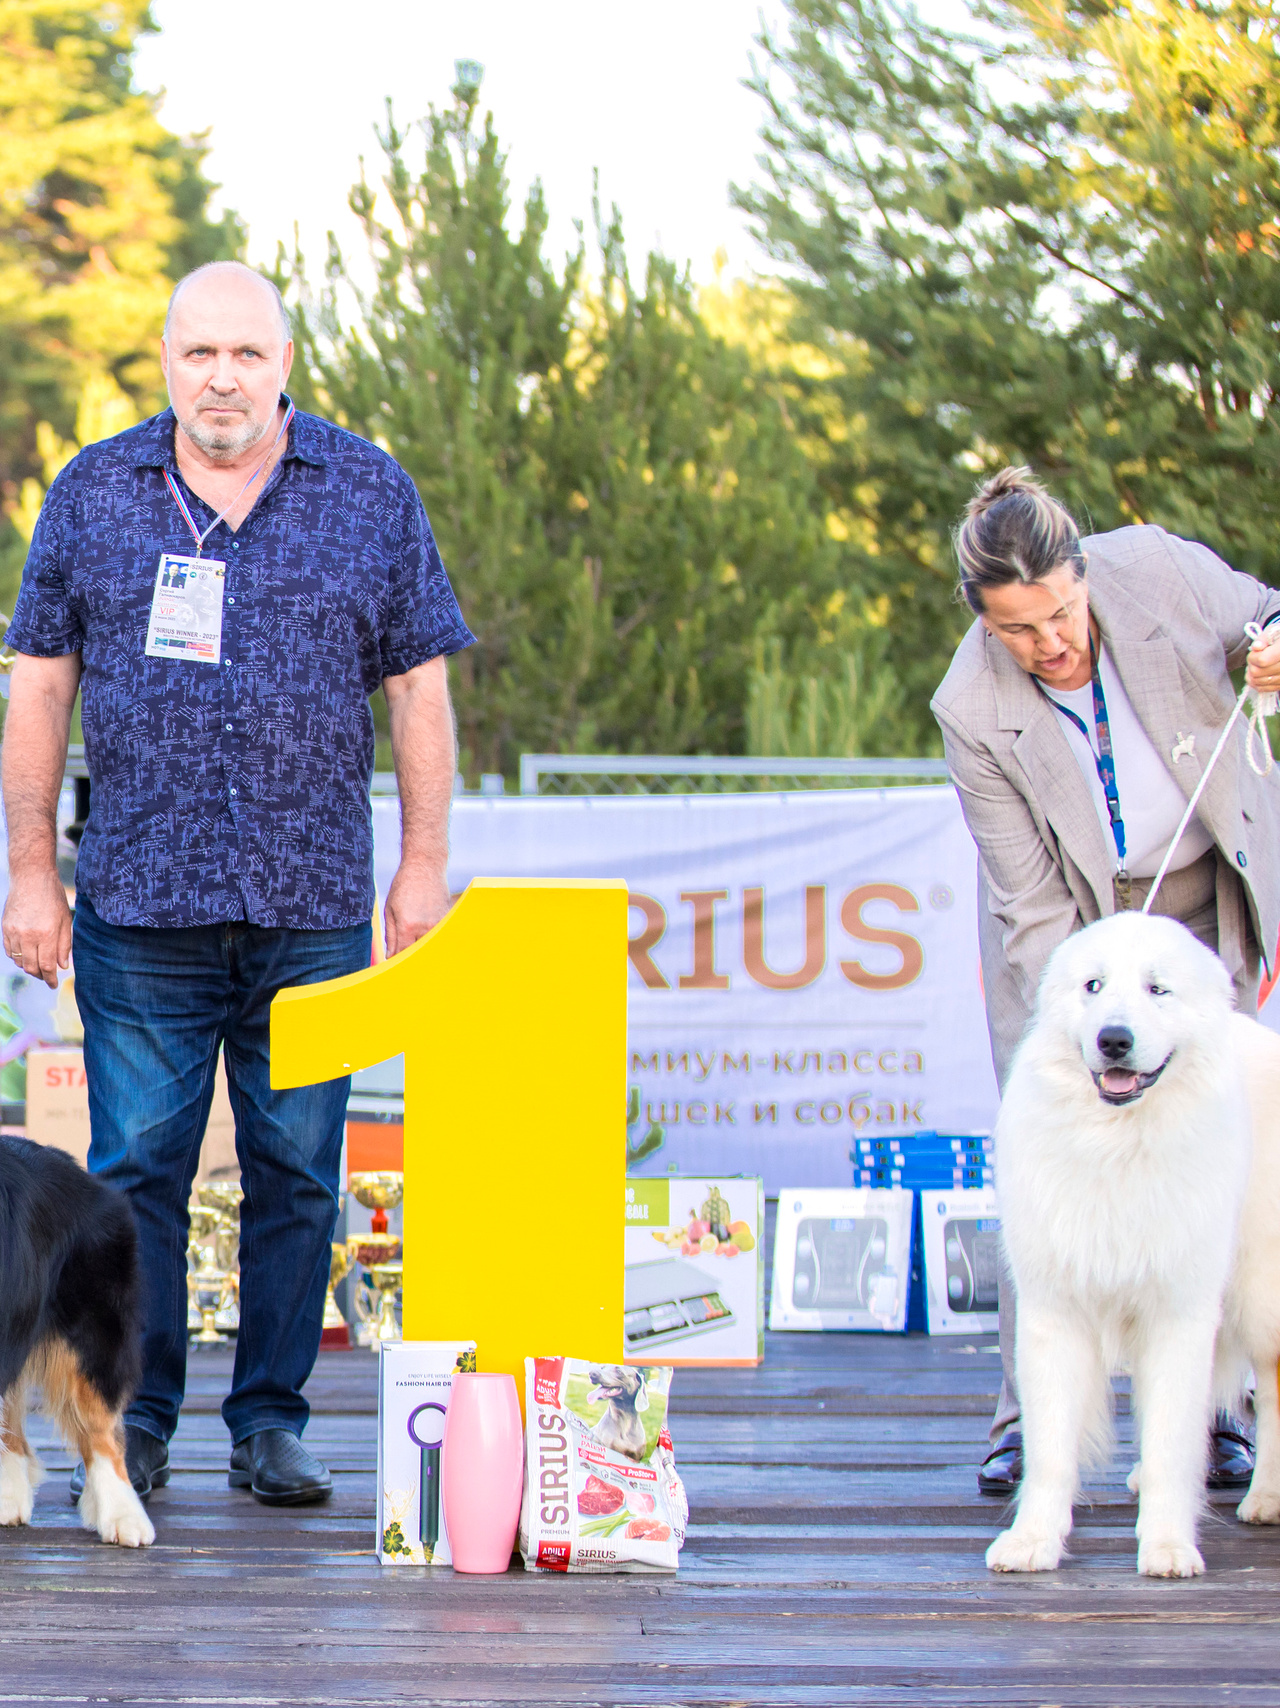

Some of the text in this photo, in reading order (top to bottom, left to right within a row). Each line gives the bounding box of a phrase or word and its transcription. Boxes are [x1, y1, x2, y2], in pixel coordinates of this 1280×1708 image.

[160, 606, 175, 615] VIP
[176, 629, 199, 638] WINNER
[628, 883, 925, 991] RIUS
[631, 1050, 925, 1082] миум-класса
[646, 1091, 925, 1125] шек и собак
[538, 1413, 570, 1526] SIRIUS
[542, 1547, 567, 1556] ADULT
[577, 1549, 617, 1559] SIRIUS
